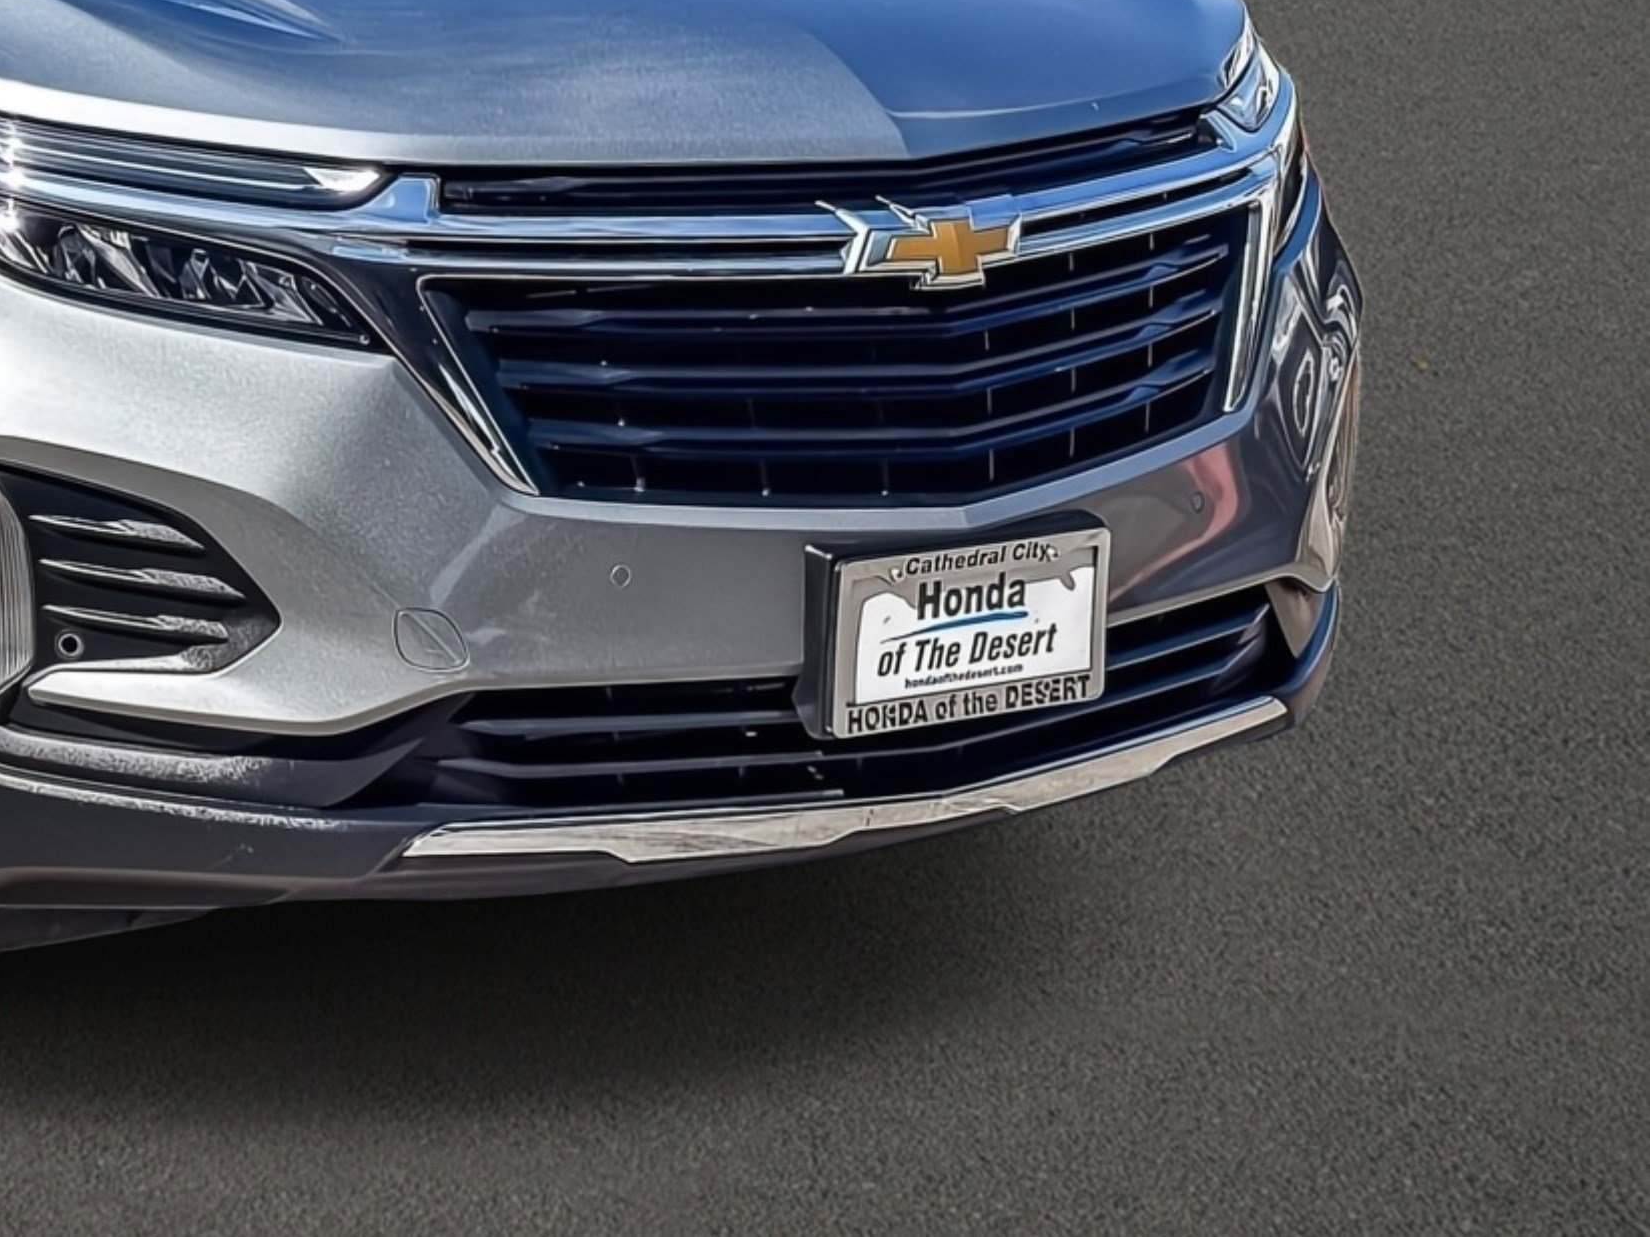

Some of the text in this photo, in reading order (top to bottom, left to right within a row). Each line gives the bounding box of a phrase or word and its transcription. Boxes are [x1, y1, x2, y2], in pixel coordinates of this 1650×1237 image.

[905, 540, 1053, 575] Cathedral City
[917, 572, 1027, 620] Honda
[877, 623, 1058, 677] of The Desert
[904, 663, 1024, 689] hondaofthedesert.com
[847, 674, 1092, 735] HONDA of the DESERT
